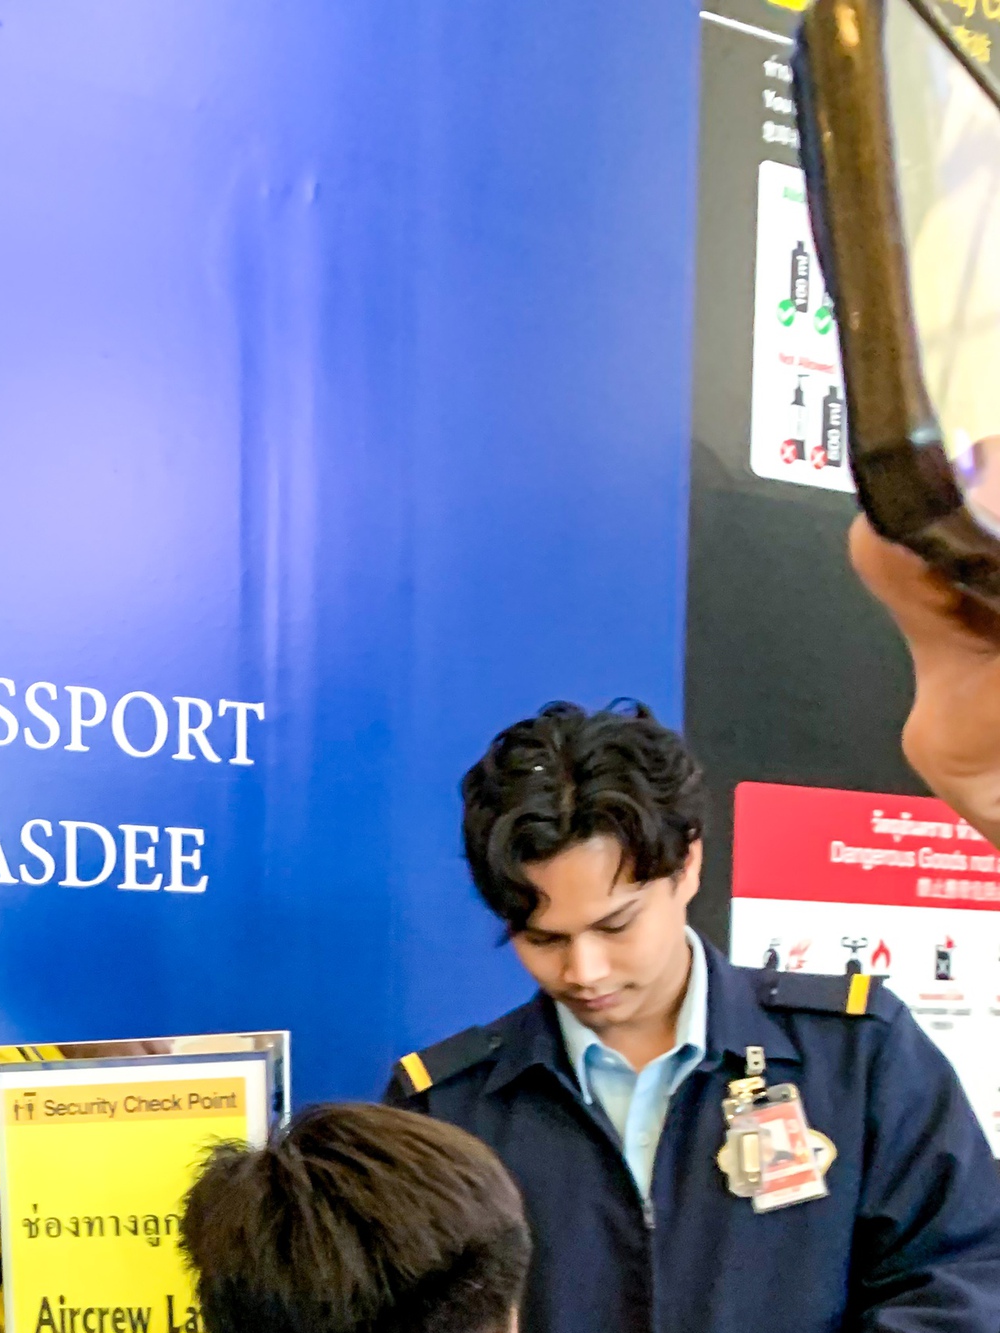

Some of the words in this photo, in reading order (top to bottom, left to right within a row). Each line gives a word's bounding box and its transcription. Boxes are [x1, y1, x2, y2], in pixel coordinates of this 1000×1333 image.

[830, 840, 916, 871] Dangerous
[918, 846, 968, 871] Goods
[43, 1097, 118, 1119] Security
[123, 1093, 183, 1113] Check
[187, 1091, 237, 1110] Point
